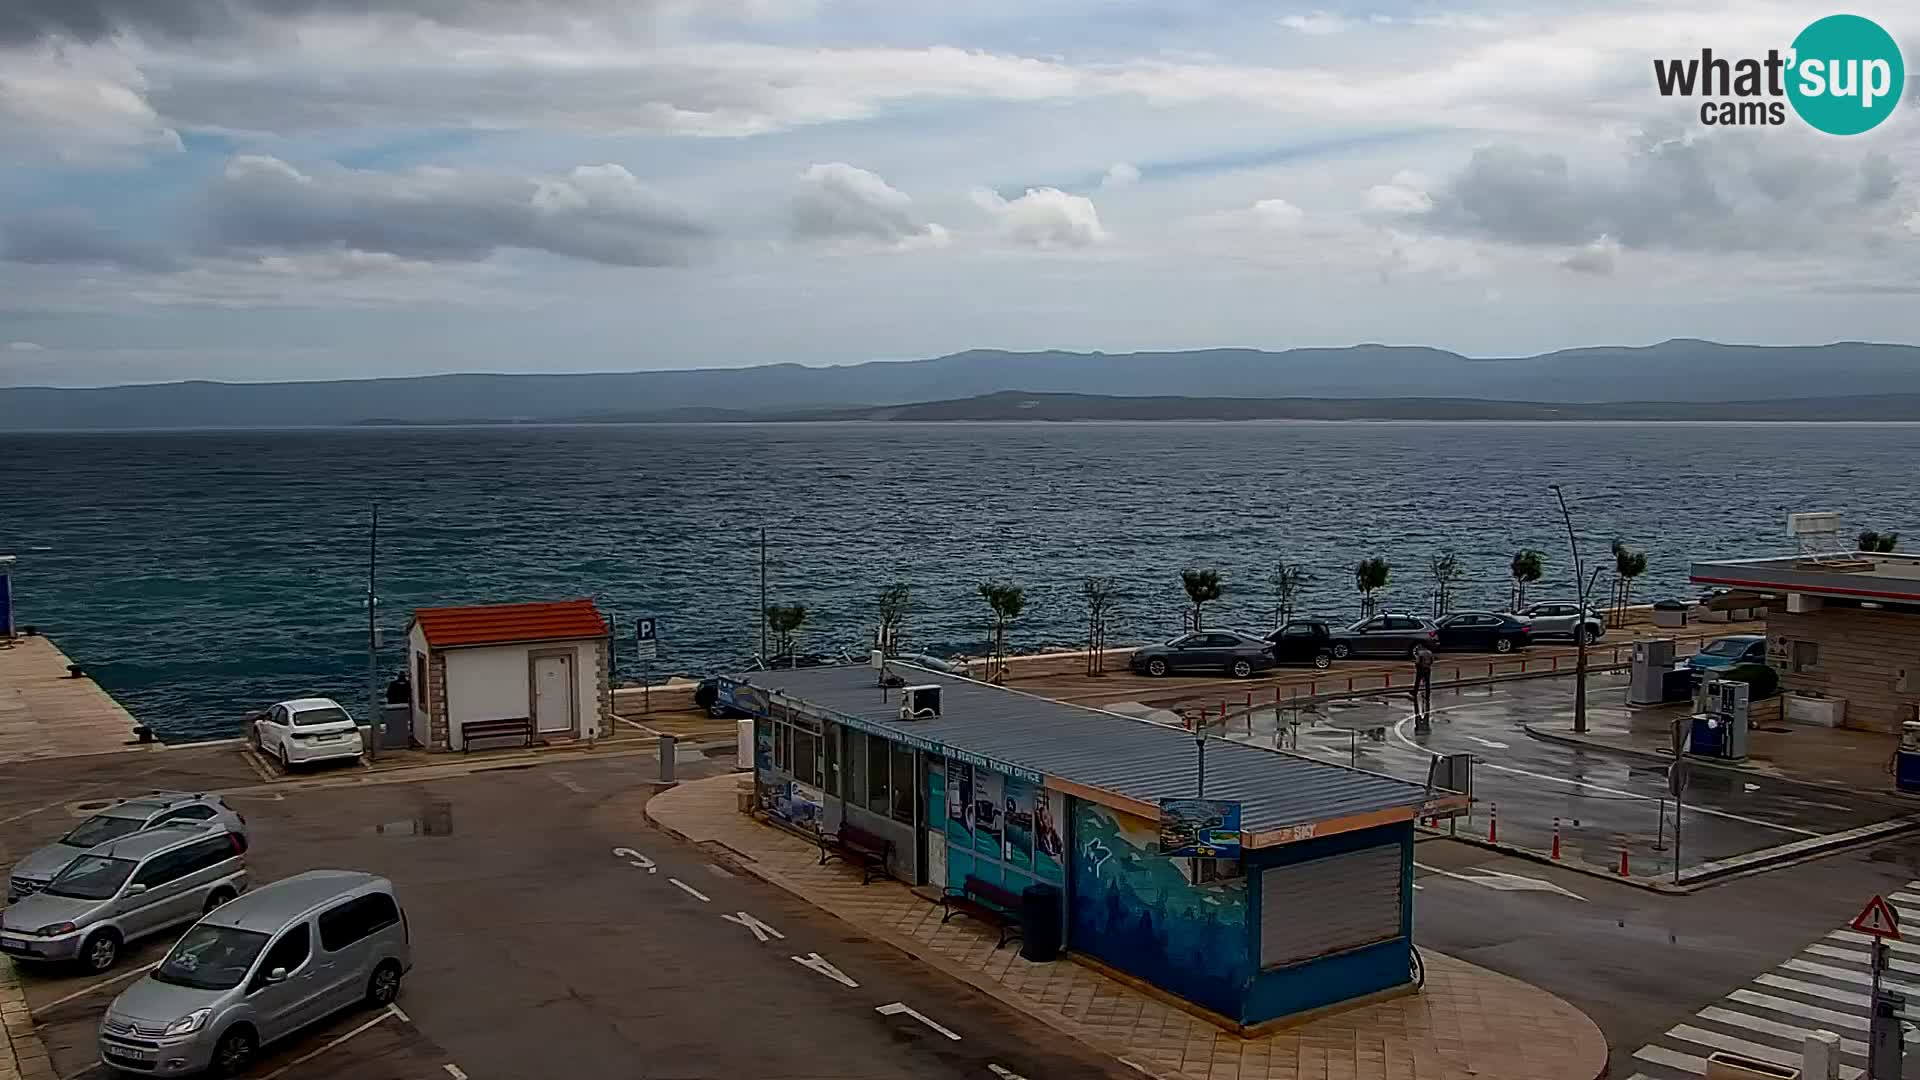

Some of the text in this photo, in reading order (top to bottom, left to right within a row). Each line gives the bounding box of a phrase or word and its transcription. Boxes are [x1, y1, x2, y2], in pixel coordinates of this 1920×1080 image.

[641, 621, 651, 637] P
[943, 746, 956, 759] BUS
[957, 751, 987, 768] STATION
[989, 761, 1013, 777] TICKET
[1014, 768, 1040, 783] OFFICE
